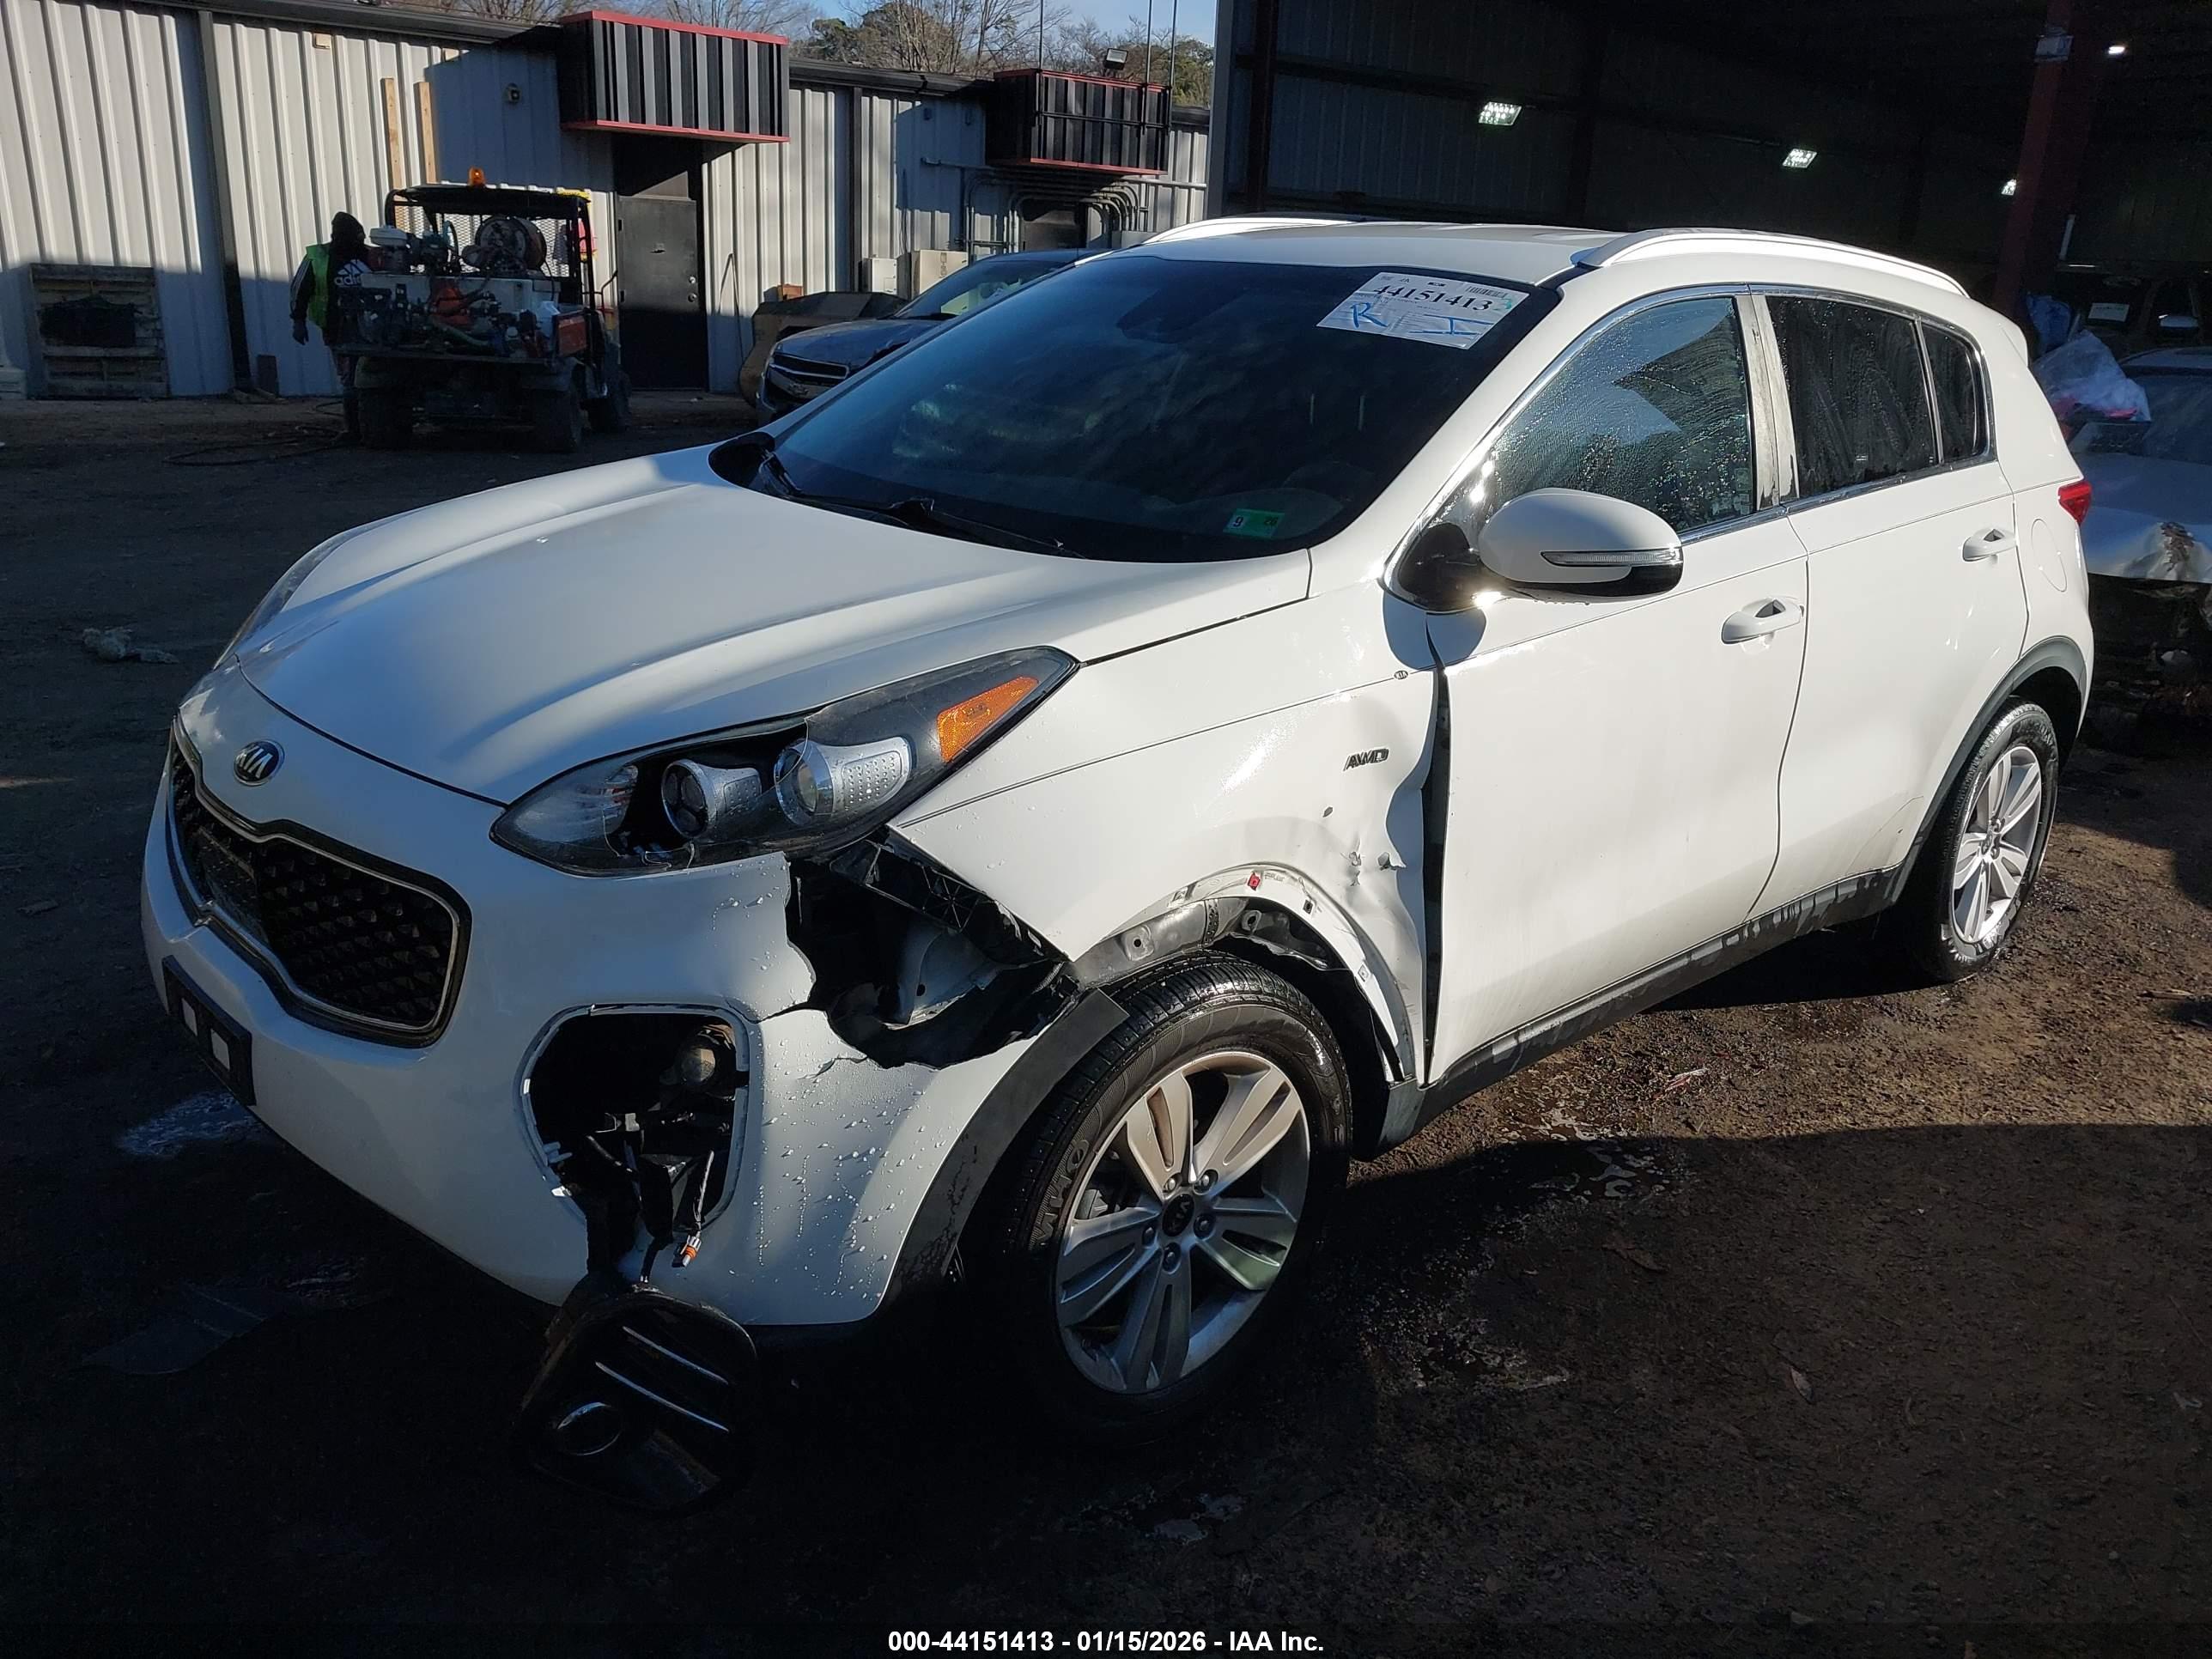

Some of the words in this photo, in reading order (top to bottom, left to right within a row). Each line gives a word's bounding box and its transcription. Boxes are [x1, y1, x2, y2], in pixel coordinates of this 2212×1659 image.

[334, 274, 361, 286] adi
[1373, 285, 1493, 311] 44151413
[1350, 302, 1389, 328] R
[1342, 748, 1389, 772] AWD
